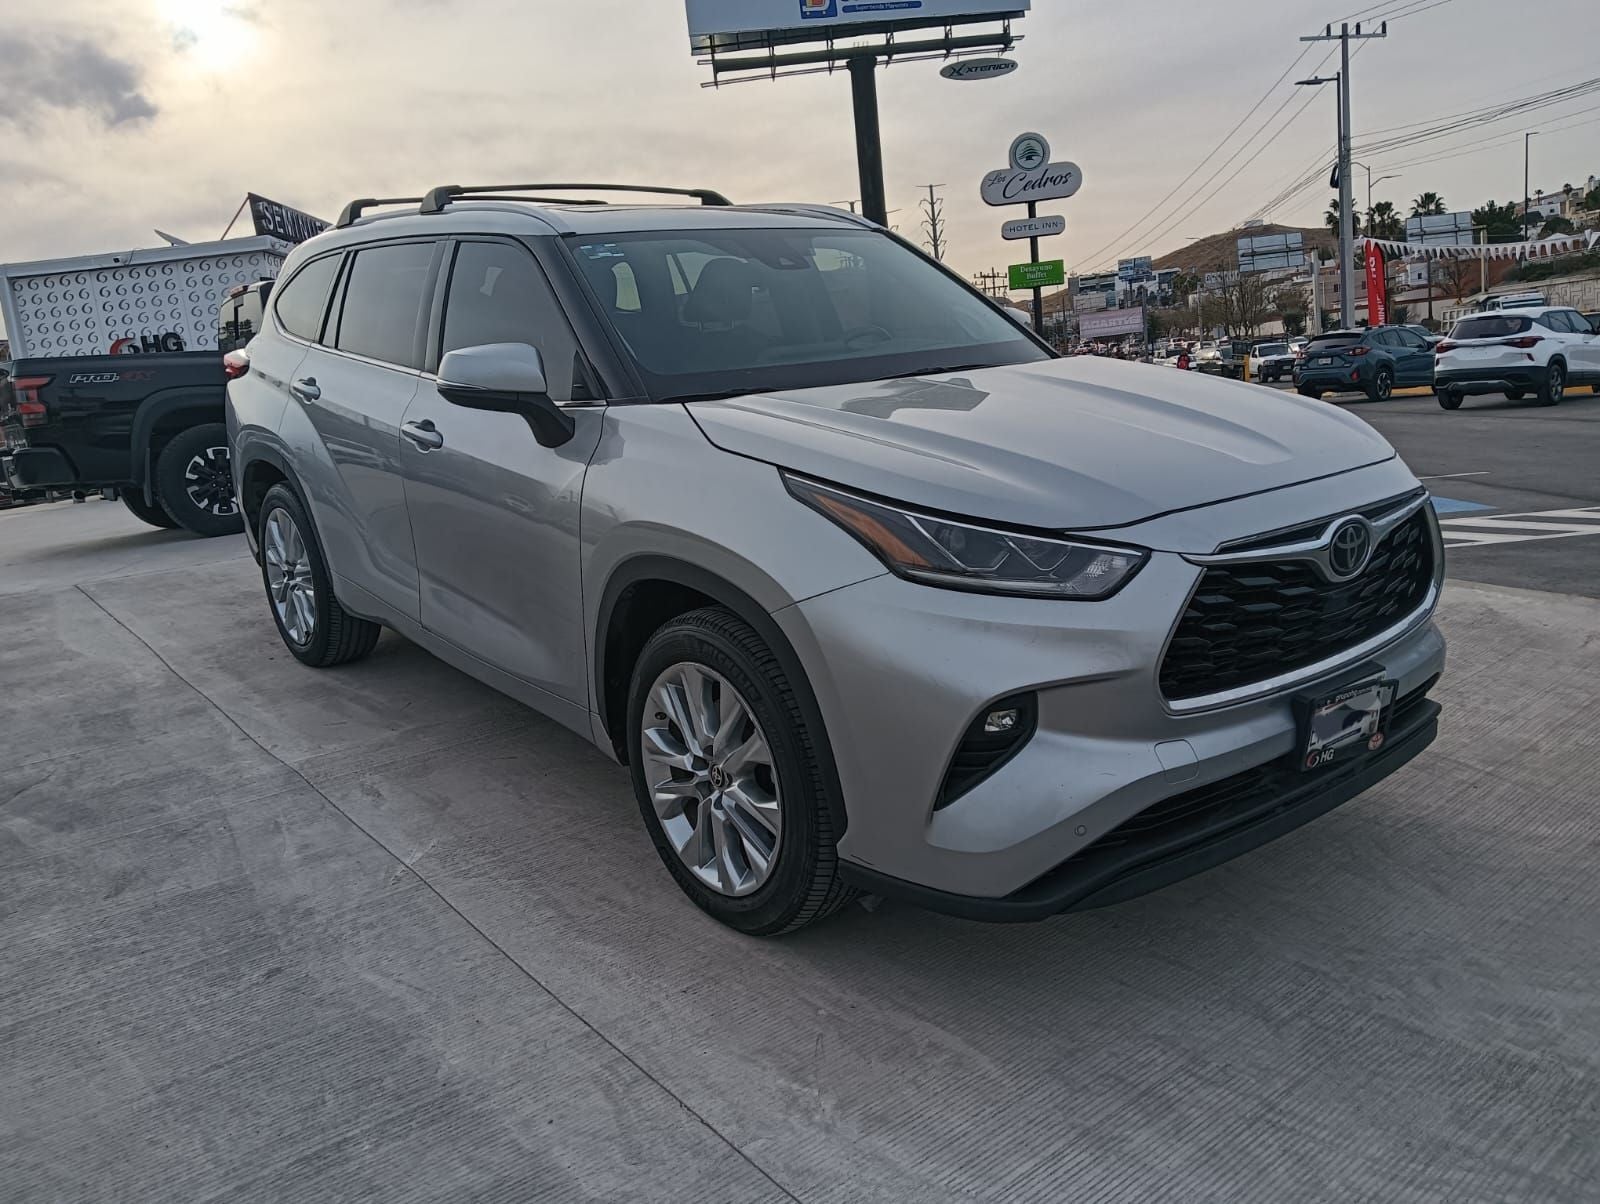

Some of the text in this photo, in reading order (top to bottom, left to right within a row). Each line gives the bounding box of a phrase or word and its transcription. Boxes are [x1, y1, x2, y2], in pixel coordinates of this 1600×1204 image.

[988, 168, 1073, 199] Los Cedros
[1009, 221, 1059, 233] HOTEL INN
[1020, 264, 1053, 273] Desayuno
[1026, 271, 1048, 280] Buffet
[140, 331, 185, 353] HG
[1320, 749, 1334, 763] HG
